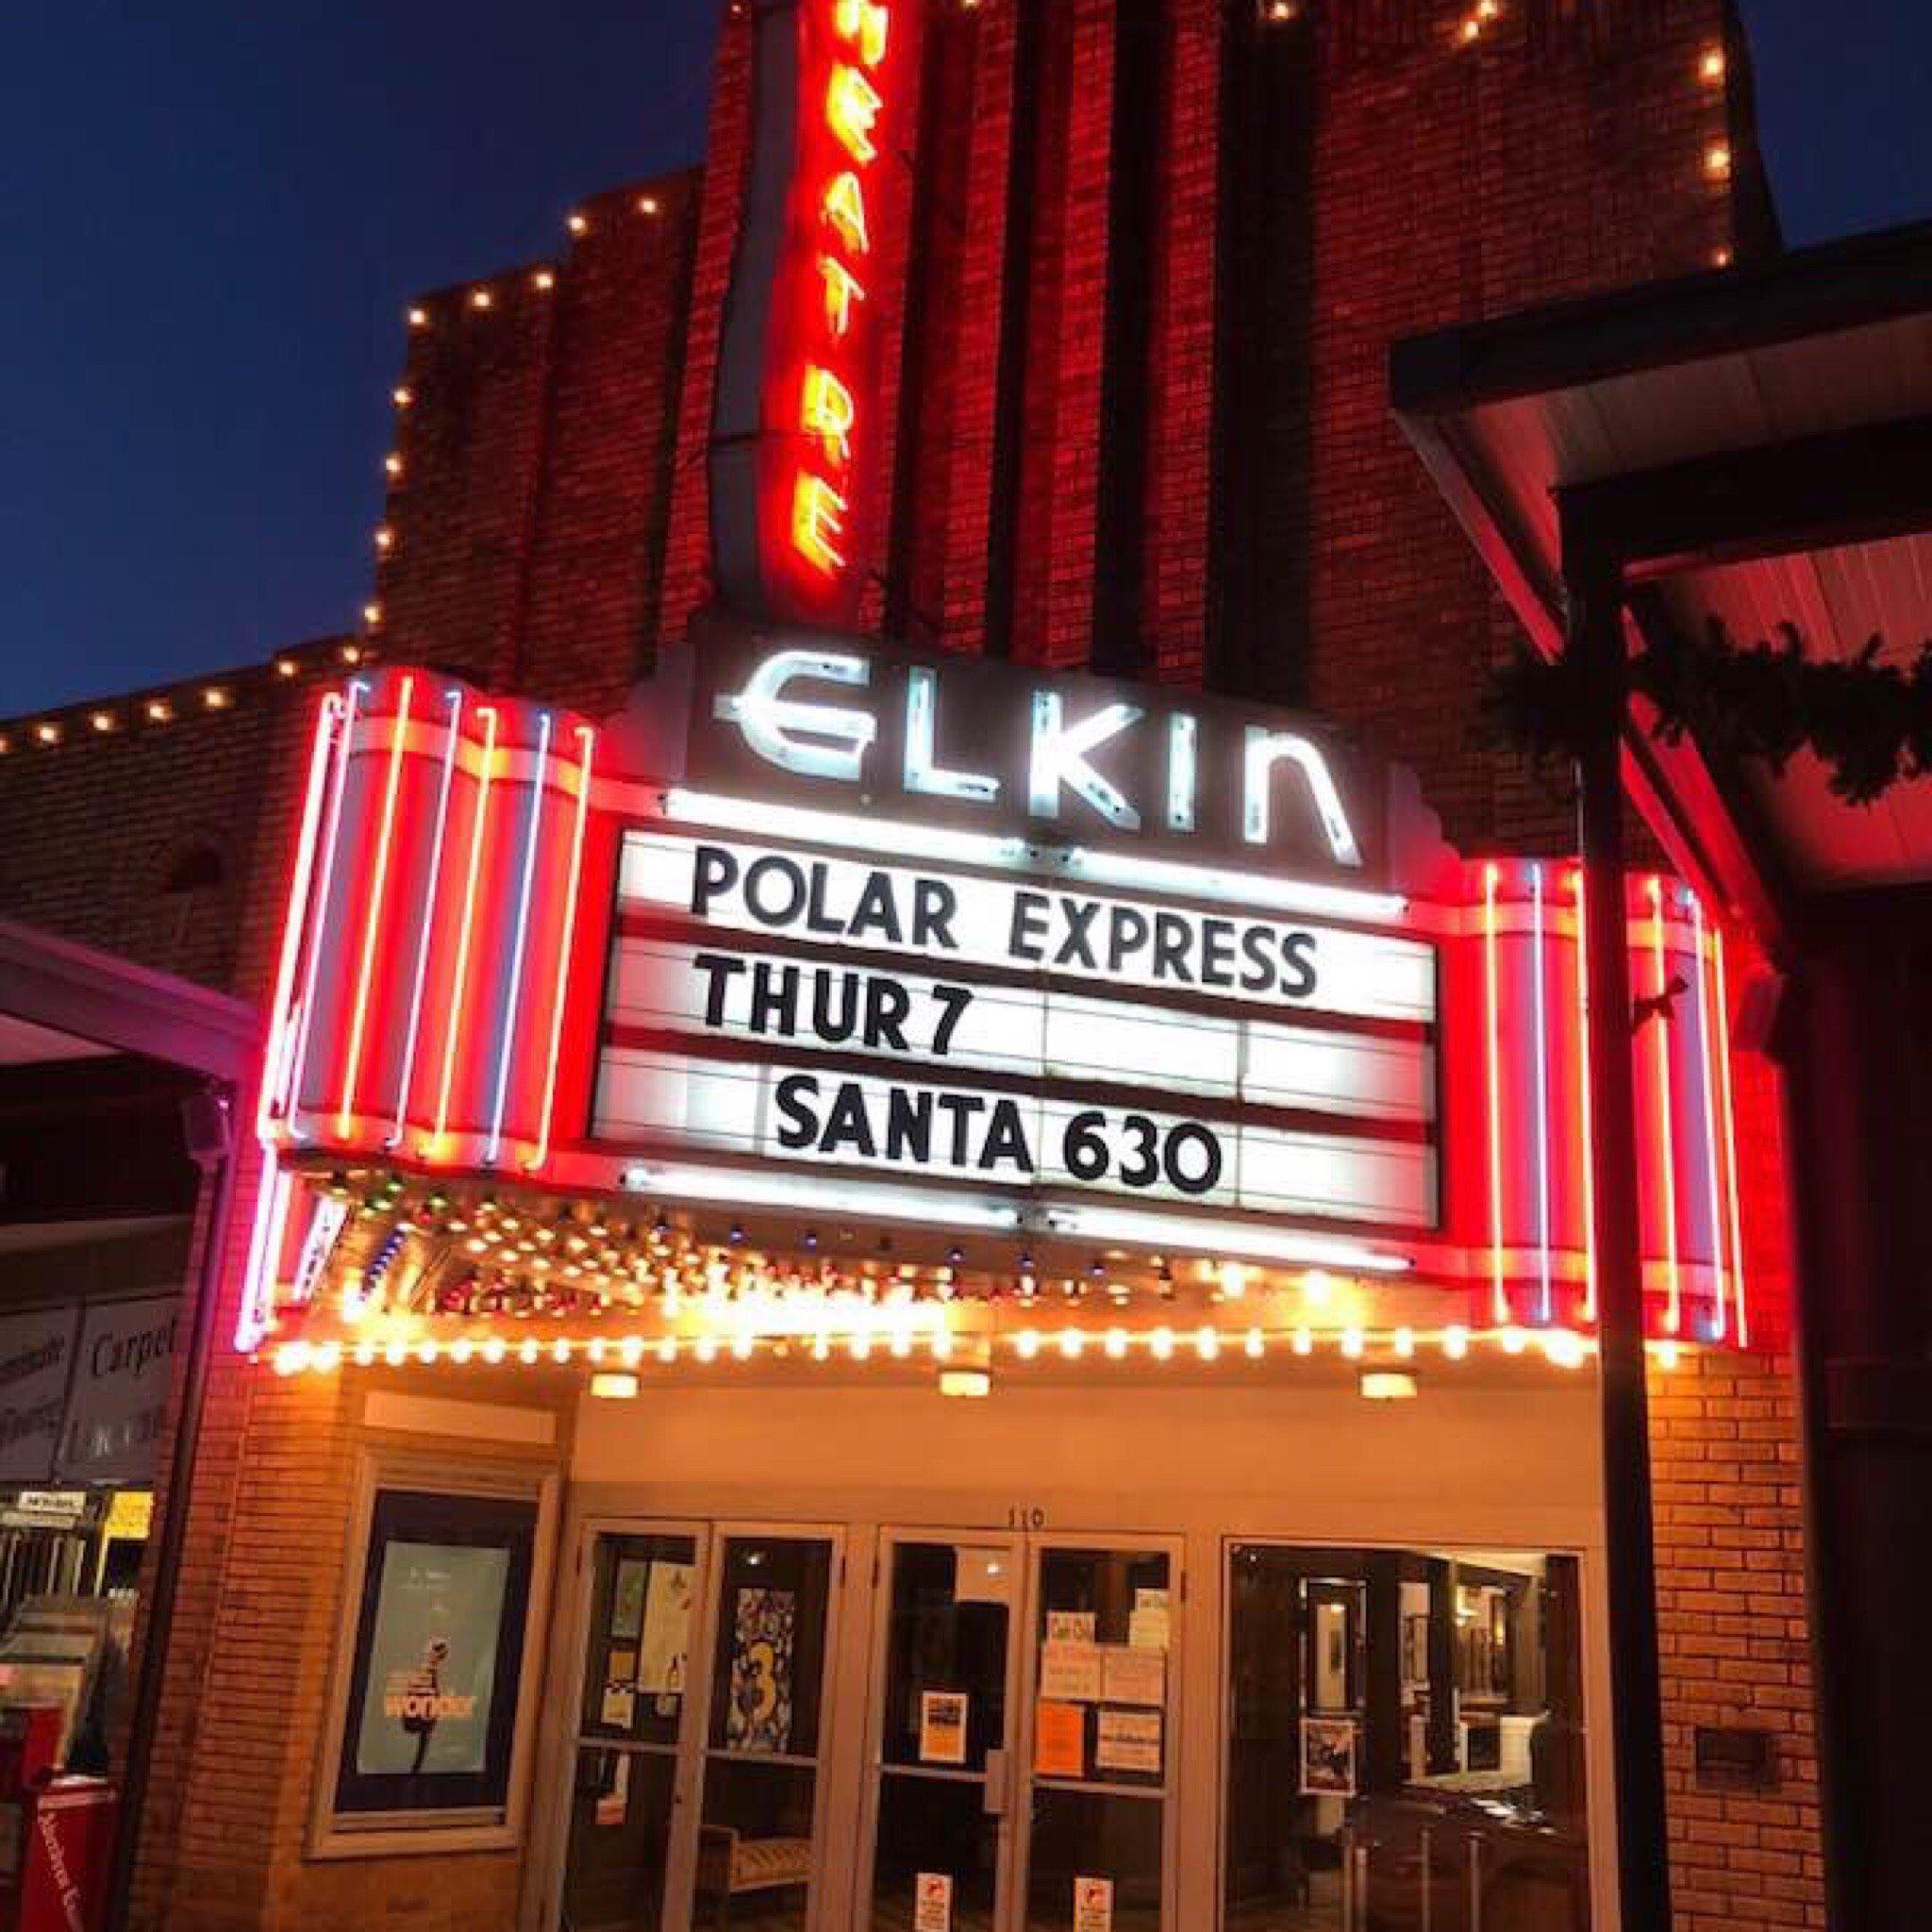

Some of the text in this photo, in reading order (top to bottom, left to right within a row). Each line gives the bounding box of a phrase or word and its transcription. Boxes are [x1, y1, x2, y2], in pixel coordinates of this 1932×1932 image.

[691, 845, 1318, 997] POLAR EXPRESS
[693, 952, 974, 1056] THUR 7
[774, 1074, 1223, 1194] SANTA 630
[1008, 1506, 1044, 1528] 110
